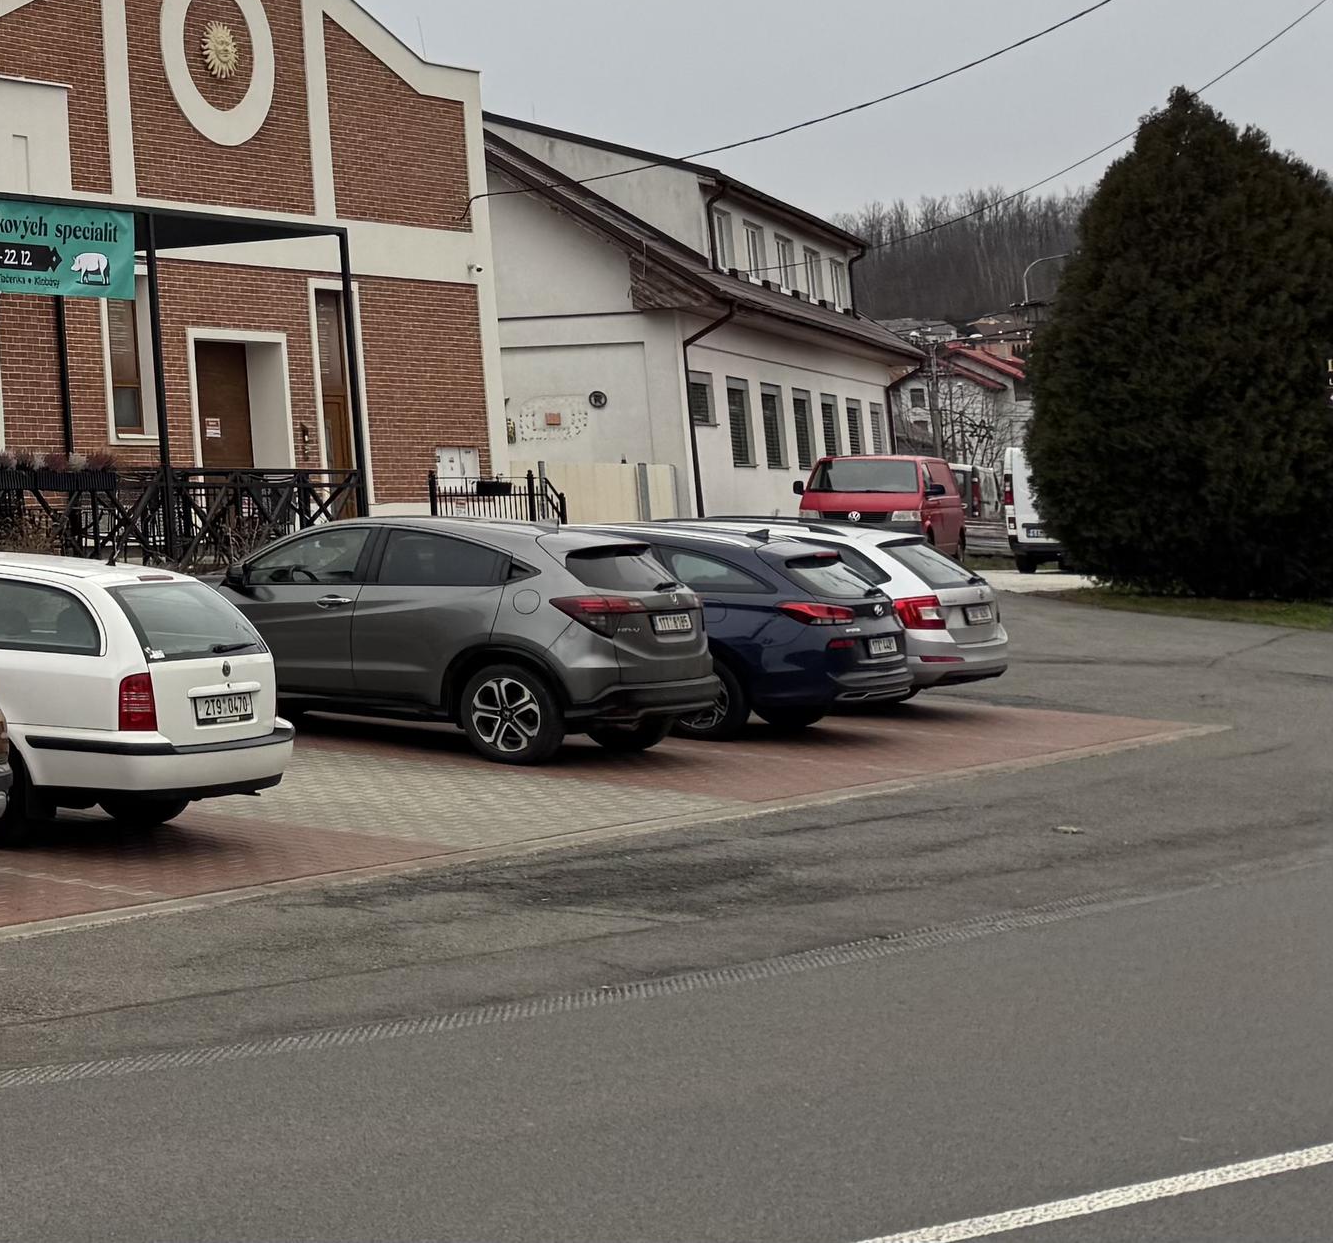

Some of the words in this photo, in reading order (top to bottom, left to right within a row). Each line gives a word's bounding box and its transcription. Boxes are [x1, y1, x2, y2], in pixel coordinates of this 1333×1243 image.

[55, 221, 118, 245] specialit
[204, 698, 222, 716] 2T9
[228, 696, 248, 714] 0470
